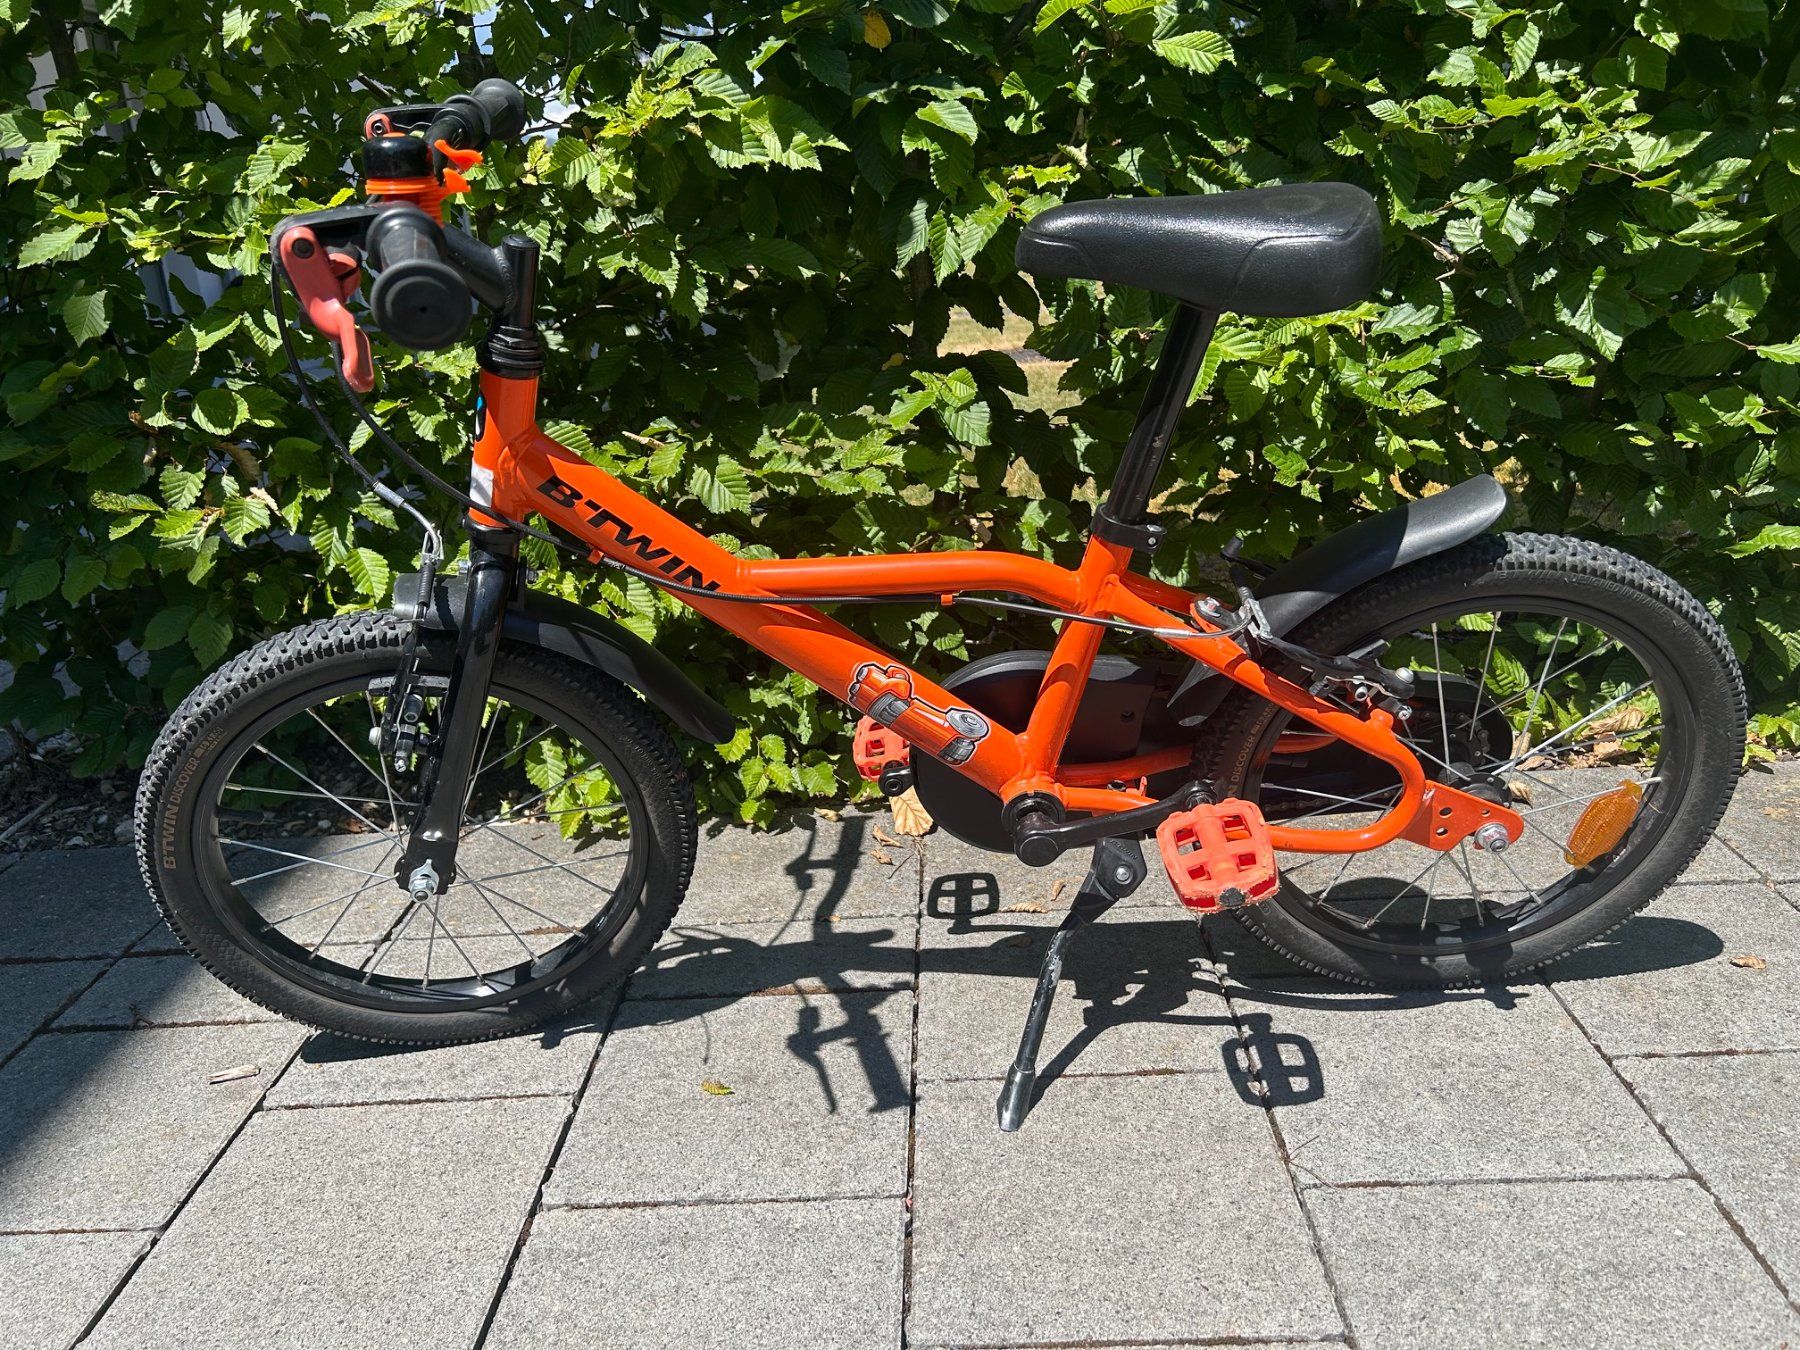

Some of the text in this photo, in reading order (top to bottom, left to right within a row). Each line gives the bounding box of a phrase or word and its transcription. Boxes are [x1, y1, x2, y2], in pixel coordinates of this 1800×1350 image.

[536, 475, 721, 591] B'TWIN
[170, 757, 200, 805] DISCOVER
[1231, 735, 1256, 782] DISCOVER
